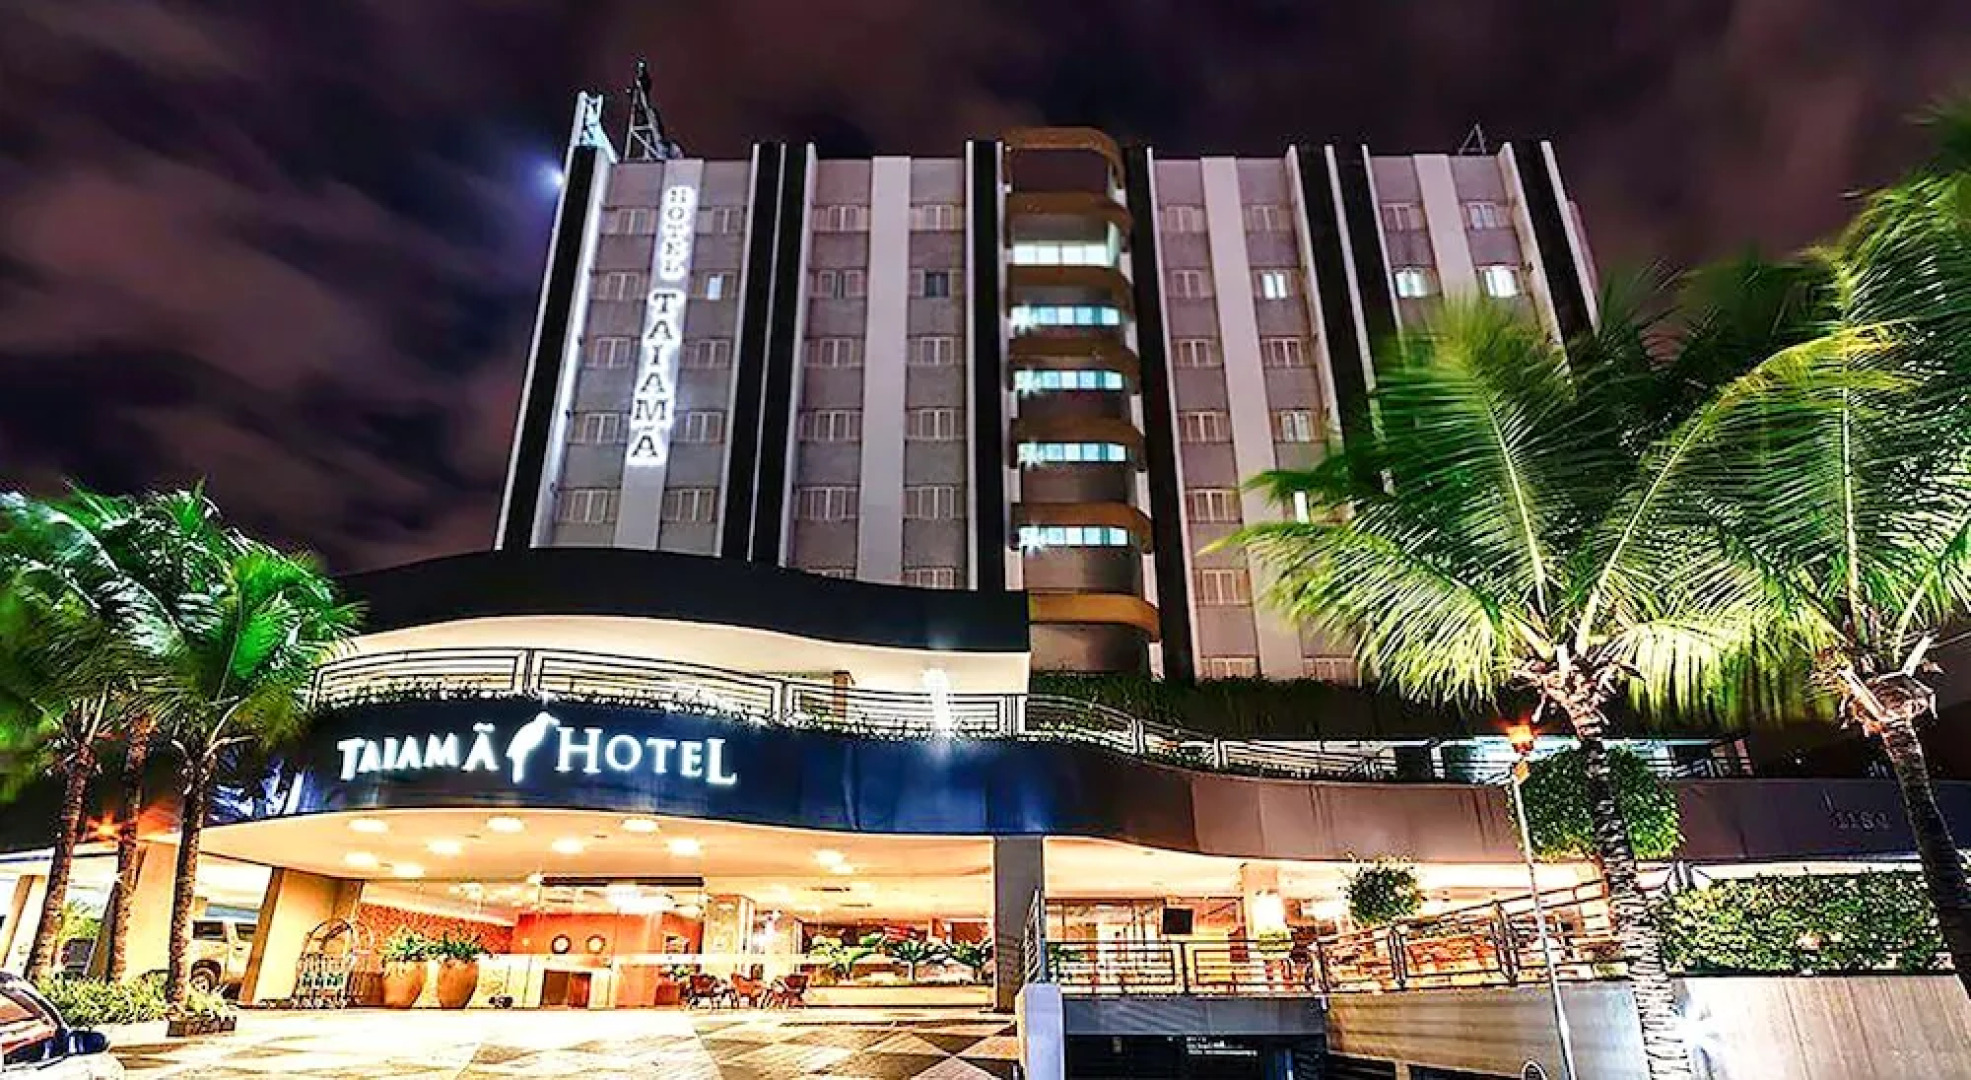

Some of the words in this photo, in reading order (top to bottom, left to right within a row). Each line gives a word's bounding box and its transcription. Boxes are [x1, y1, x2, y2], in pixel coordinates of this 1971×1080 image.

[662, 187, 690, 275] HOTEL
[632, 292, 677, 458] TAIAMÃ
[338, 723, 498, 780] TAIAMÃ
[556, 727, 737, 785] HOTEL
